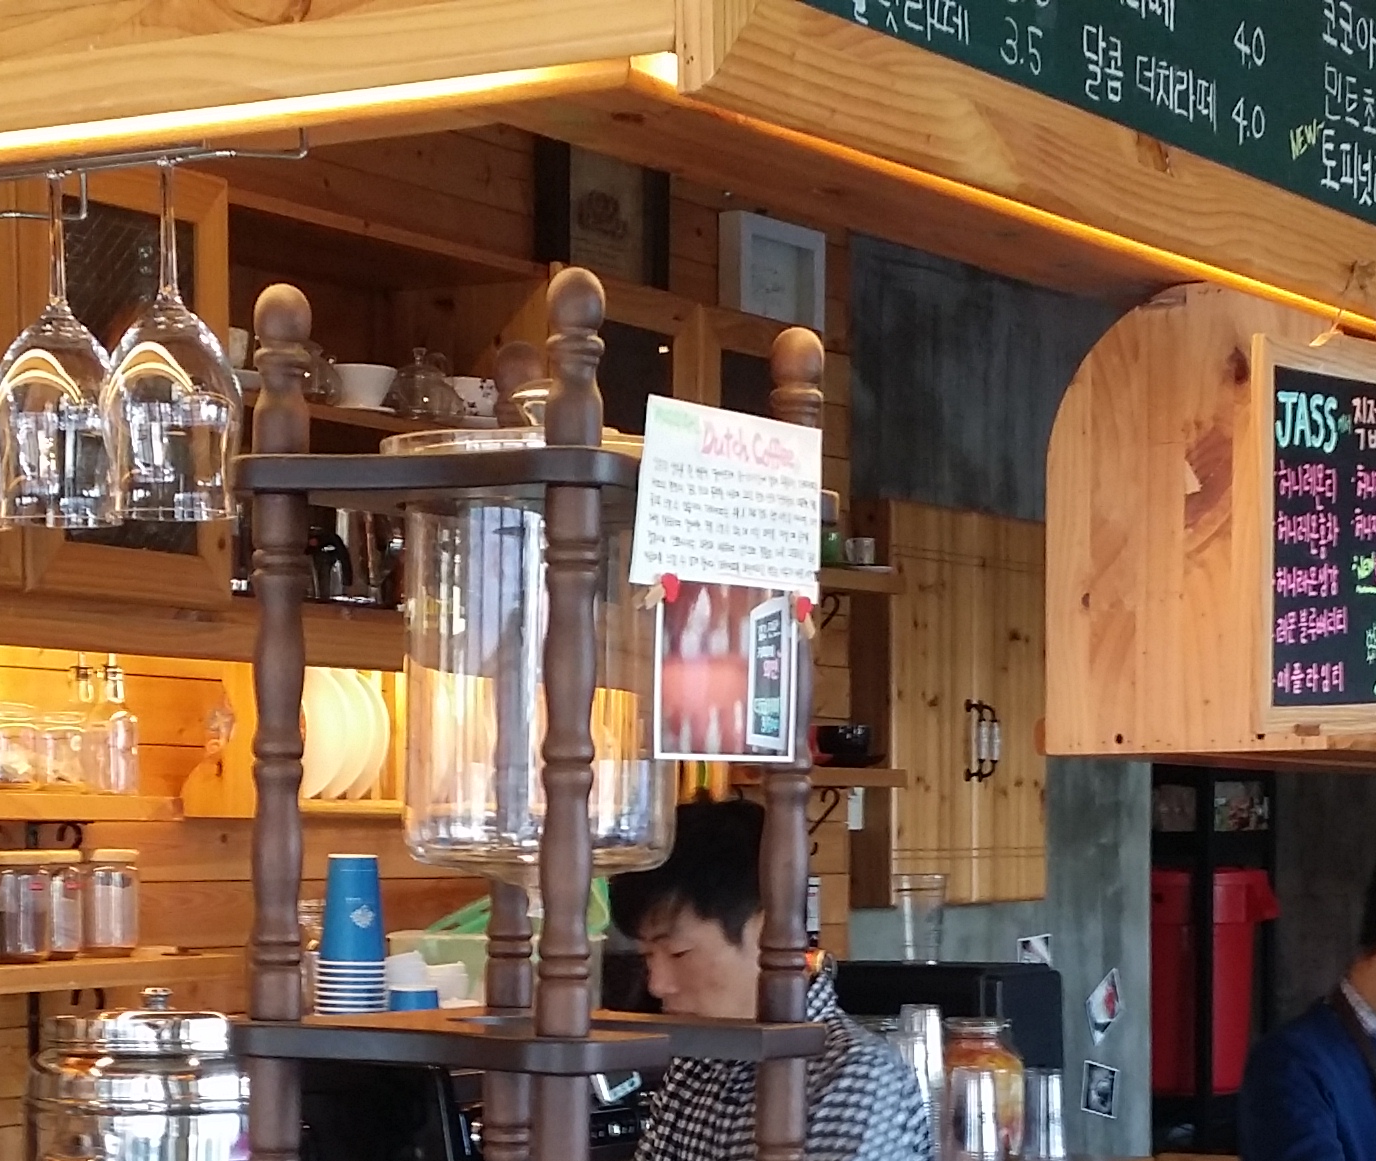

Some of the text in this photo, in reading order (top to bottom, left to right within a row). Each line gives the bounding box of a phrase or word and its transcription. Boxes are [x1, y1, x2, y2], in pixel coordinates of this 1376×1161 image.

[1000, 17, 1042, 76] 3.5
[1233, 20, 1267, 71] 4.0
[1082, 24, 1266, 145] 달콤 더치라떼 4.0
[1275, 391, 1338, 453] JASS
